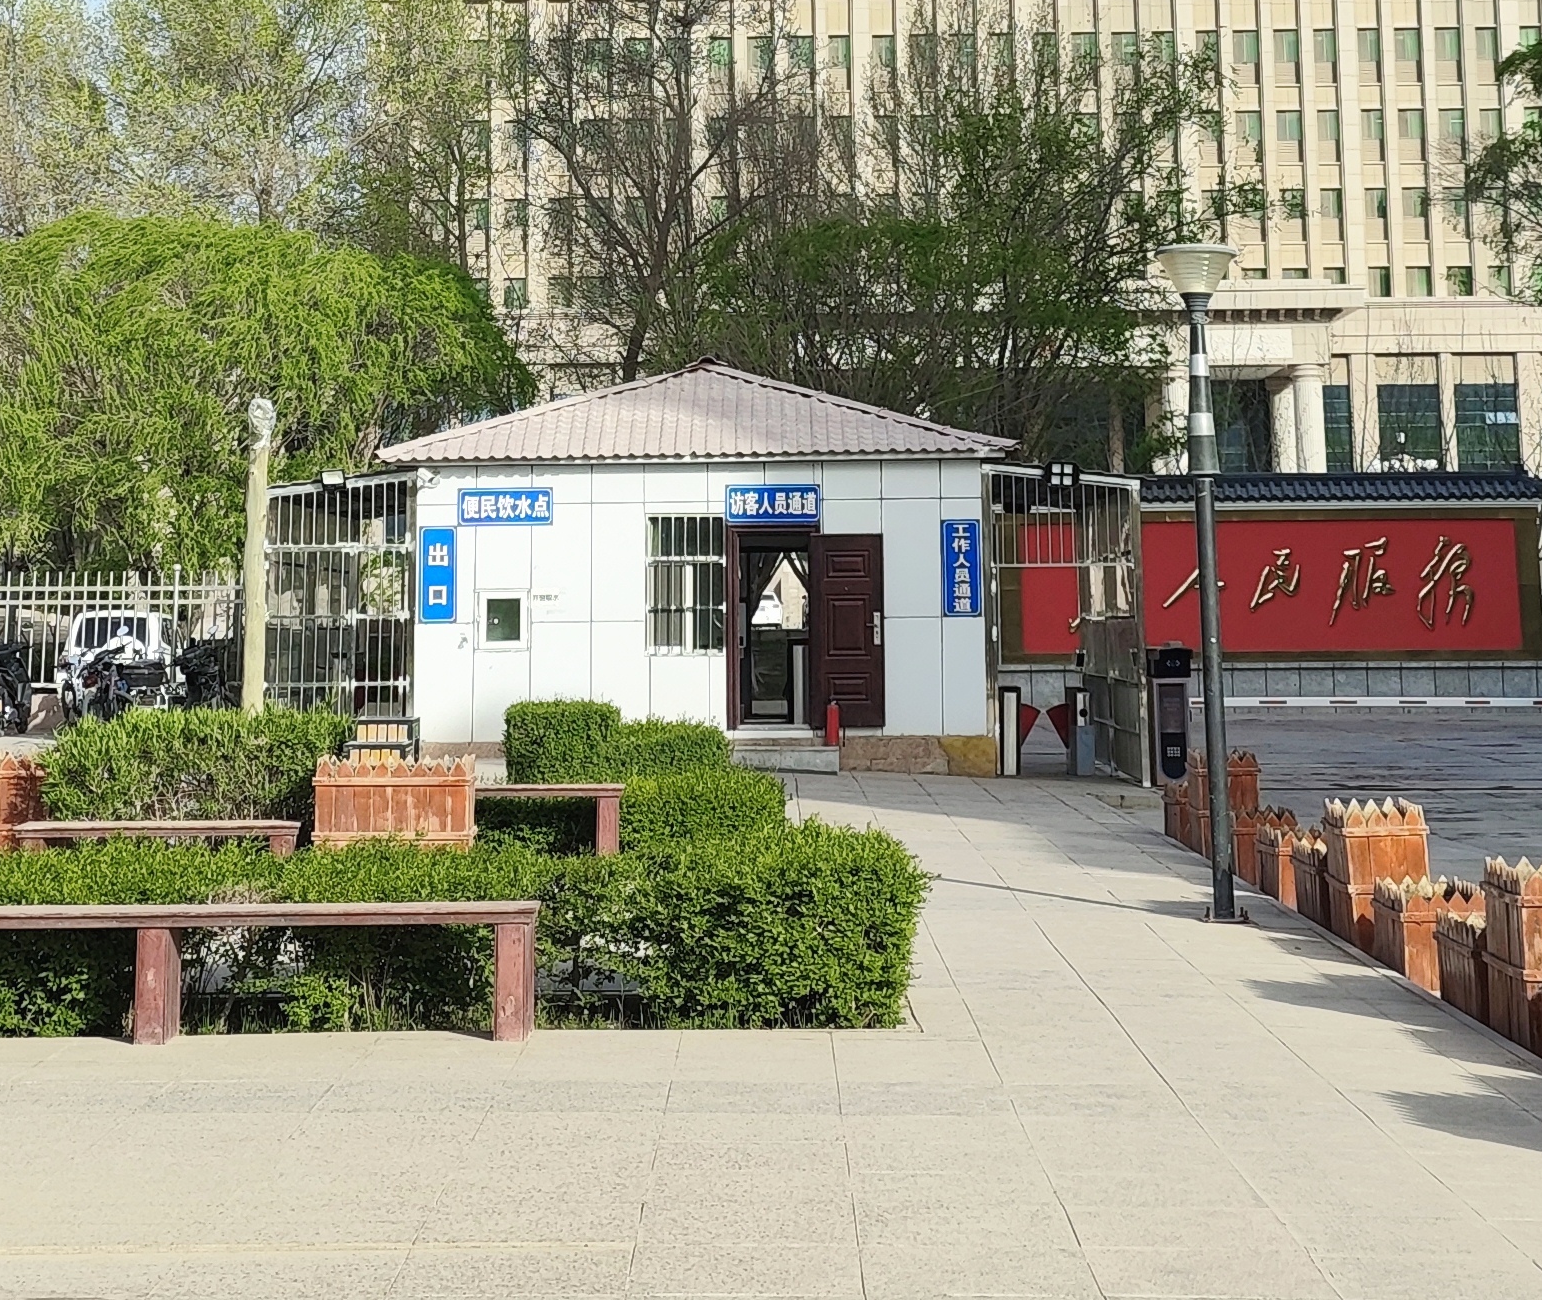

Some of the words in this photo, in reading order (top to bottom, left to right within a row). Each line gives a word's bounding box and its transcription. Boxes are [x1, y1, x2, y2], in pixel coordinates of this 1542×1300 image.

[462, 494, 550, 519] 便民饮水点
[730, 491, 817, 515] 访客人员通道
[428, 543, 449, 606] 出口
[952, 525, 971, 612] 工作人员通道
